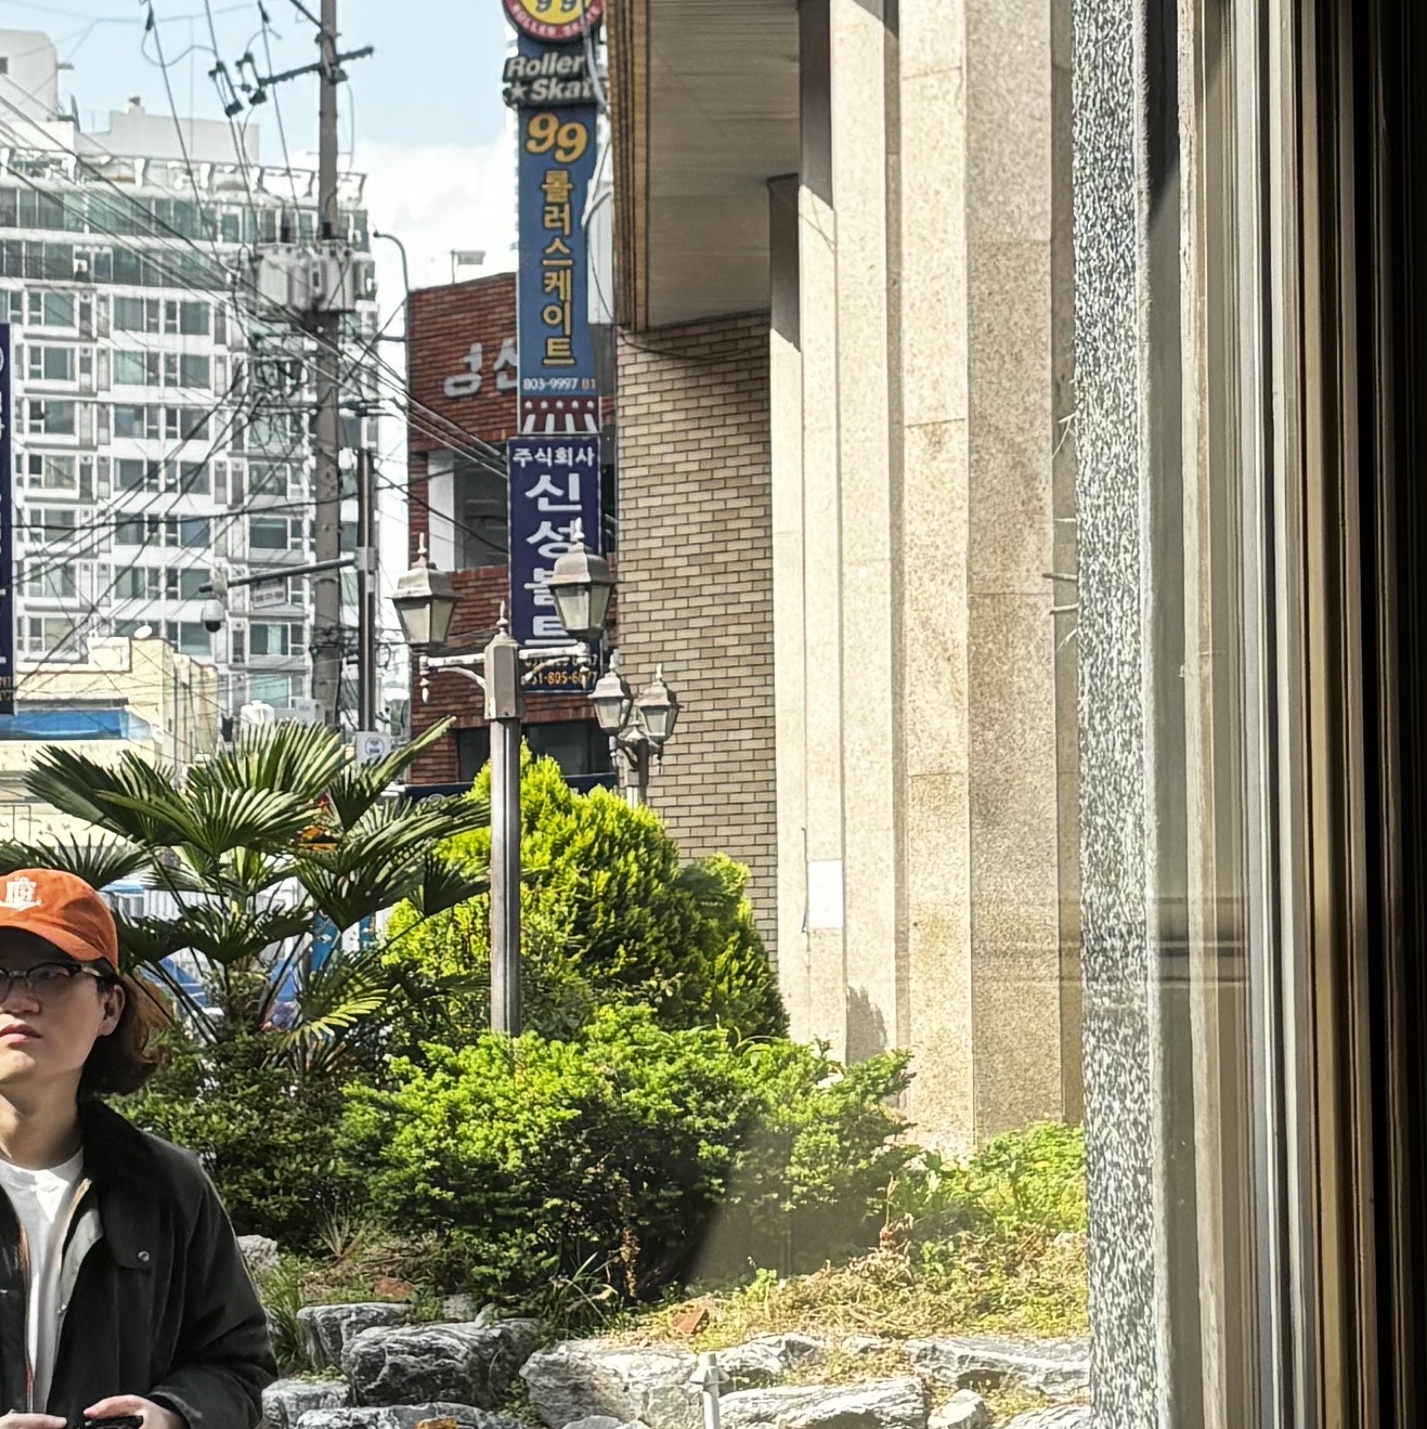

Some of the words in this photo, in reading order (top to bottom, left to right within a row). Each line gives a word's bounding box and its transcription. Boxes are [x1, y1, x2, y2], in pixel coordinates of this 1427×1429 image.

[507, 52, 584, 79] Roller
[527, 112, 587, 163] 99
[540, 169, 575, 366] 롤러스케이트
[512, 446, 595, 469] 주식회사
